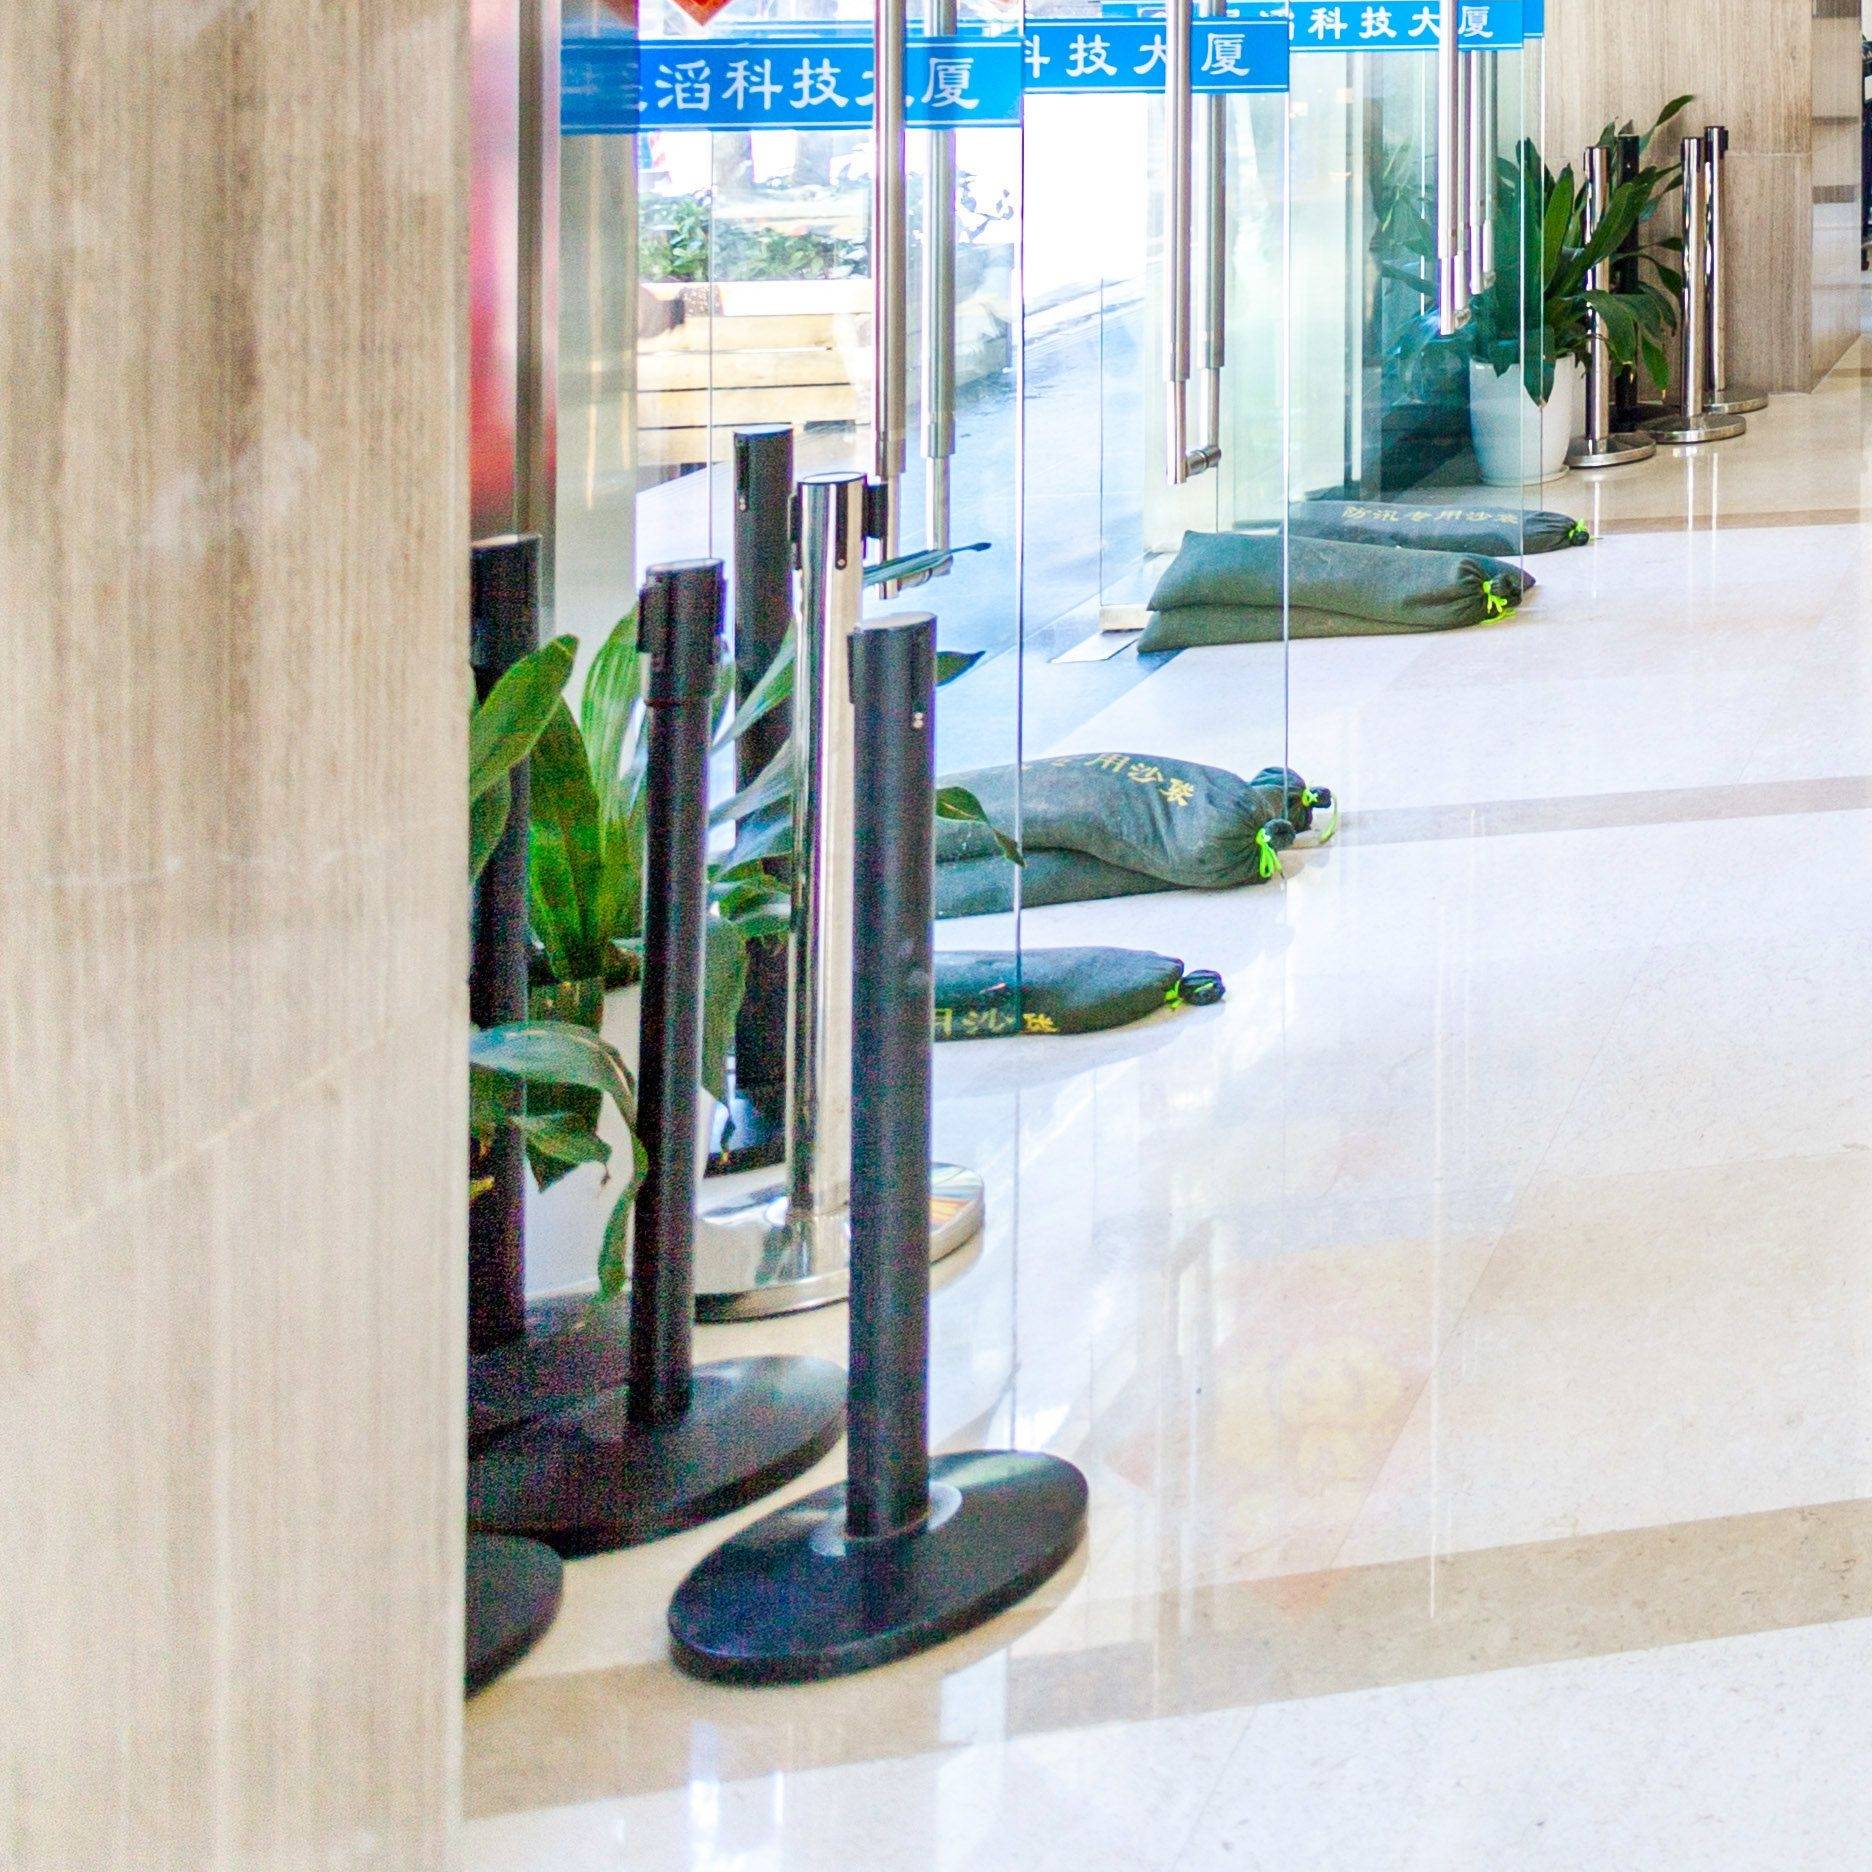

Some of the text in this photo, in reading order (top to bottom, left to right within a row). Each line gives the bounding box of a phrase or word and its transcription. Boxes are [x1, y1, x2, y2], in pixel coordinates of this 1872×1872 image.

[1270, 5, 1494, 40] 科技大厦
[628, 55, 979, 110] 滔科技厦
